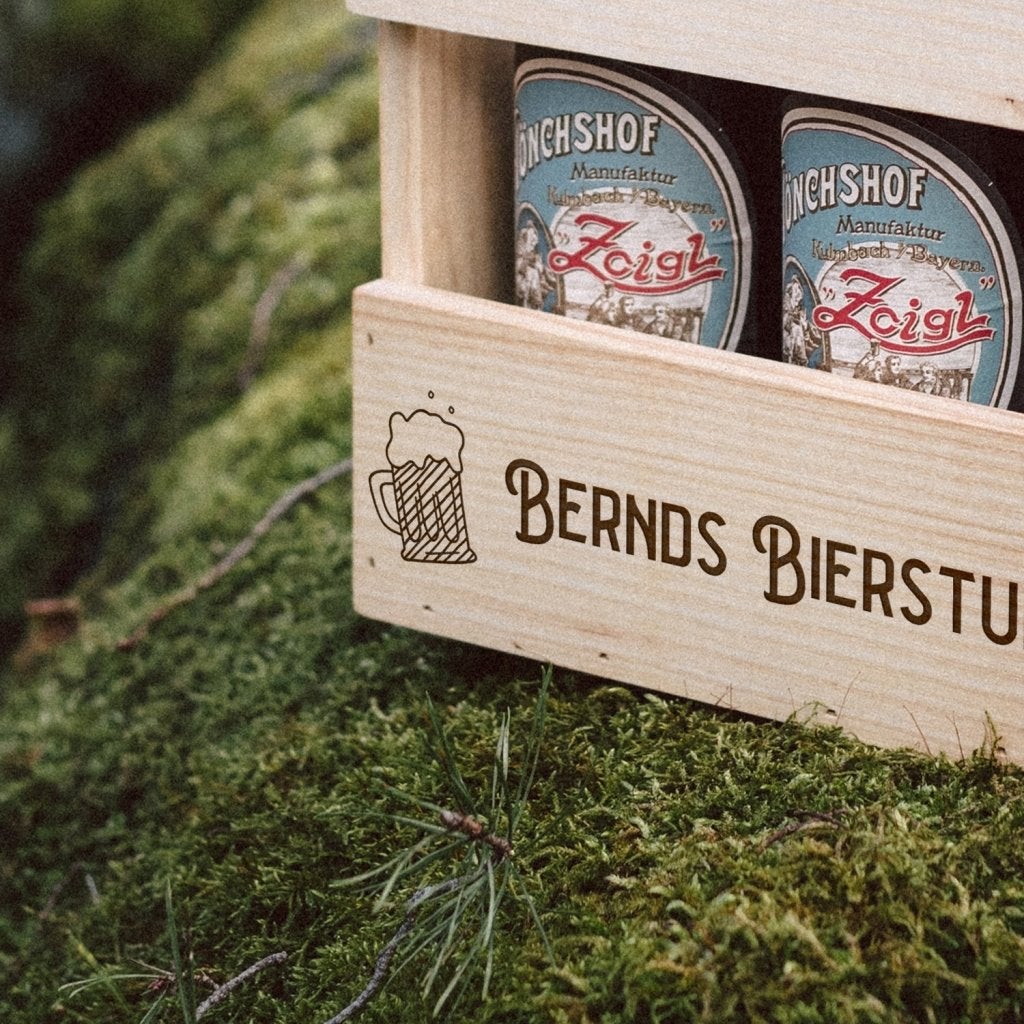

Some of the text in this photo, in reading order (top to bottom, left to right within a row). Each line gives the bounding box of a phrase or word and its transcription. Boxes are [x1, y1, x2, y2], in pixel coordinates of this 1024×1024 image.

[569, 161, 678, 186] Manufaktur
[835, 214, 946, 242] Manufaktur
[811, 238, 892, 263] Kulmbach
[504, 457, 728, 578] BERNDS
